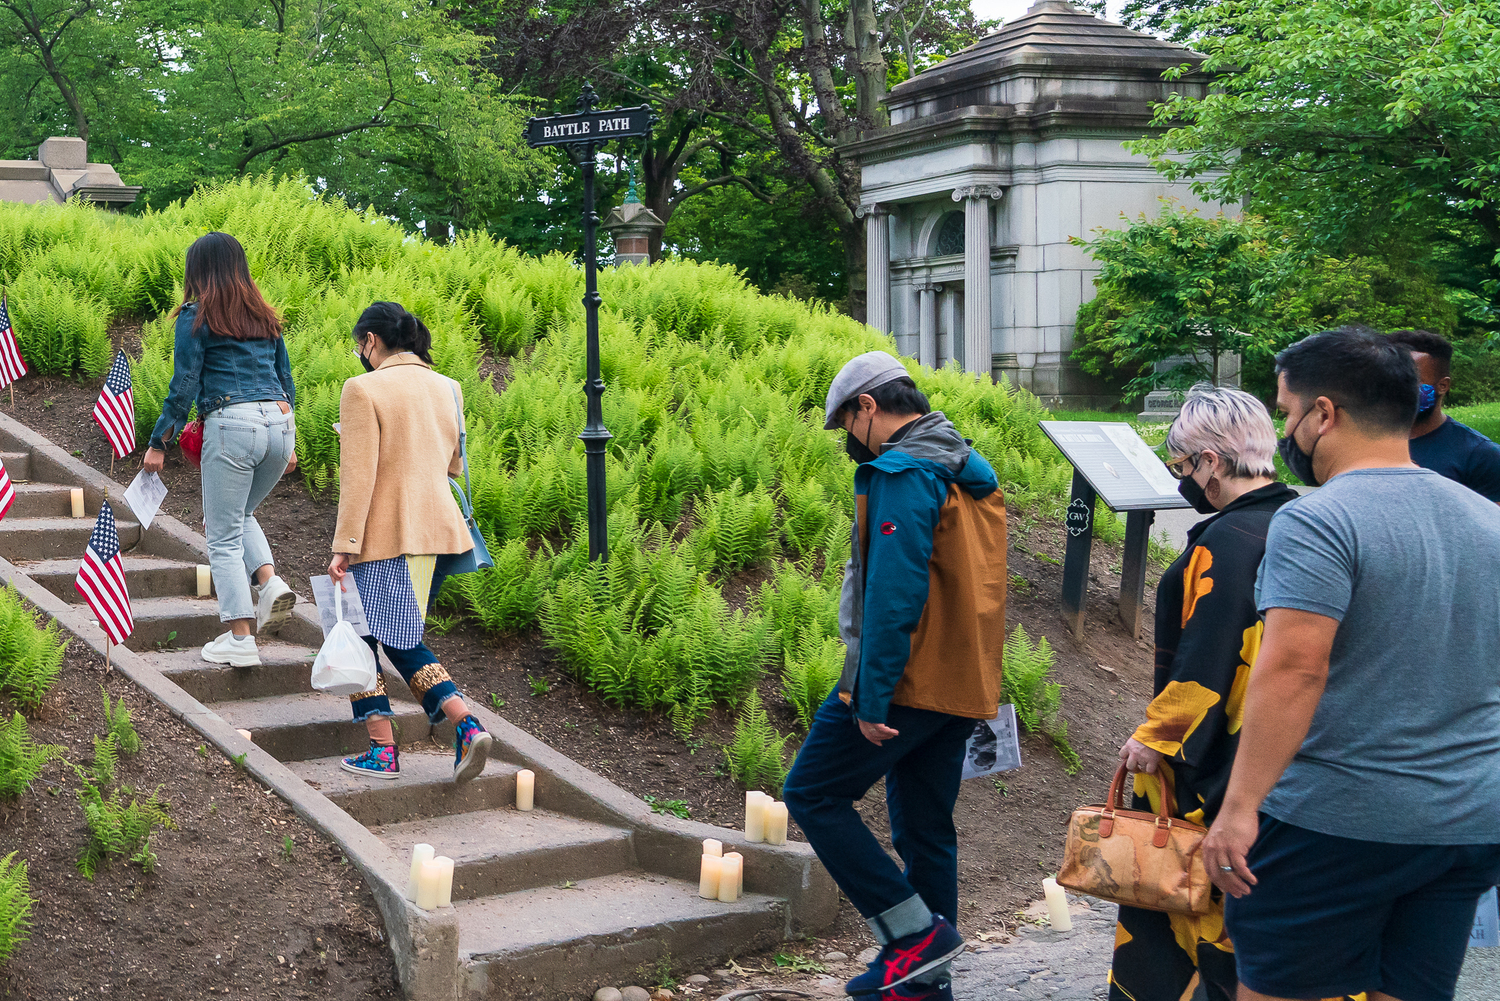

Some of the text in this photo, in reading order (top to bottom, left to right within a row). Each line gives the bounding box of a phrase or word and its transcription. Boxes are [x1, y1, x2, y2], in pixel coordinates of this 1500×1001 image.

[543, 118, 630, 138] BATTLE PATH
[1148, 400, 1174, 408] GEORGE
[1069, 512, 1085, 520] GW
